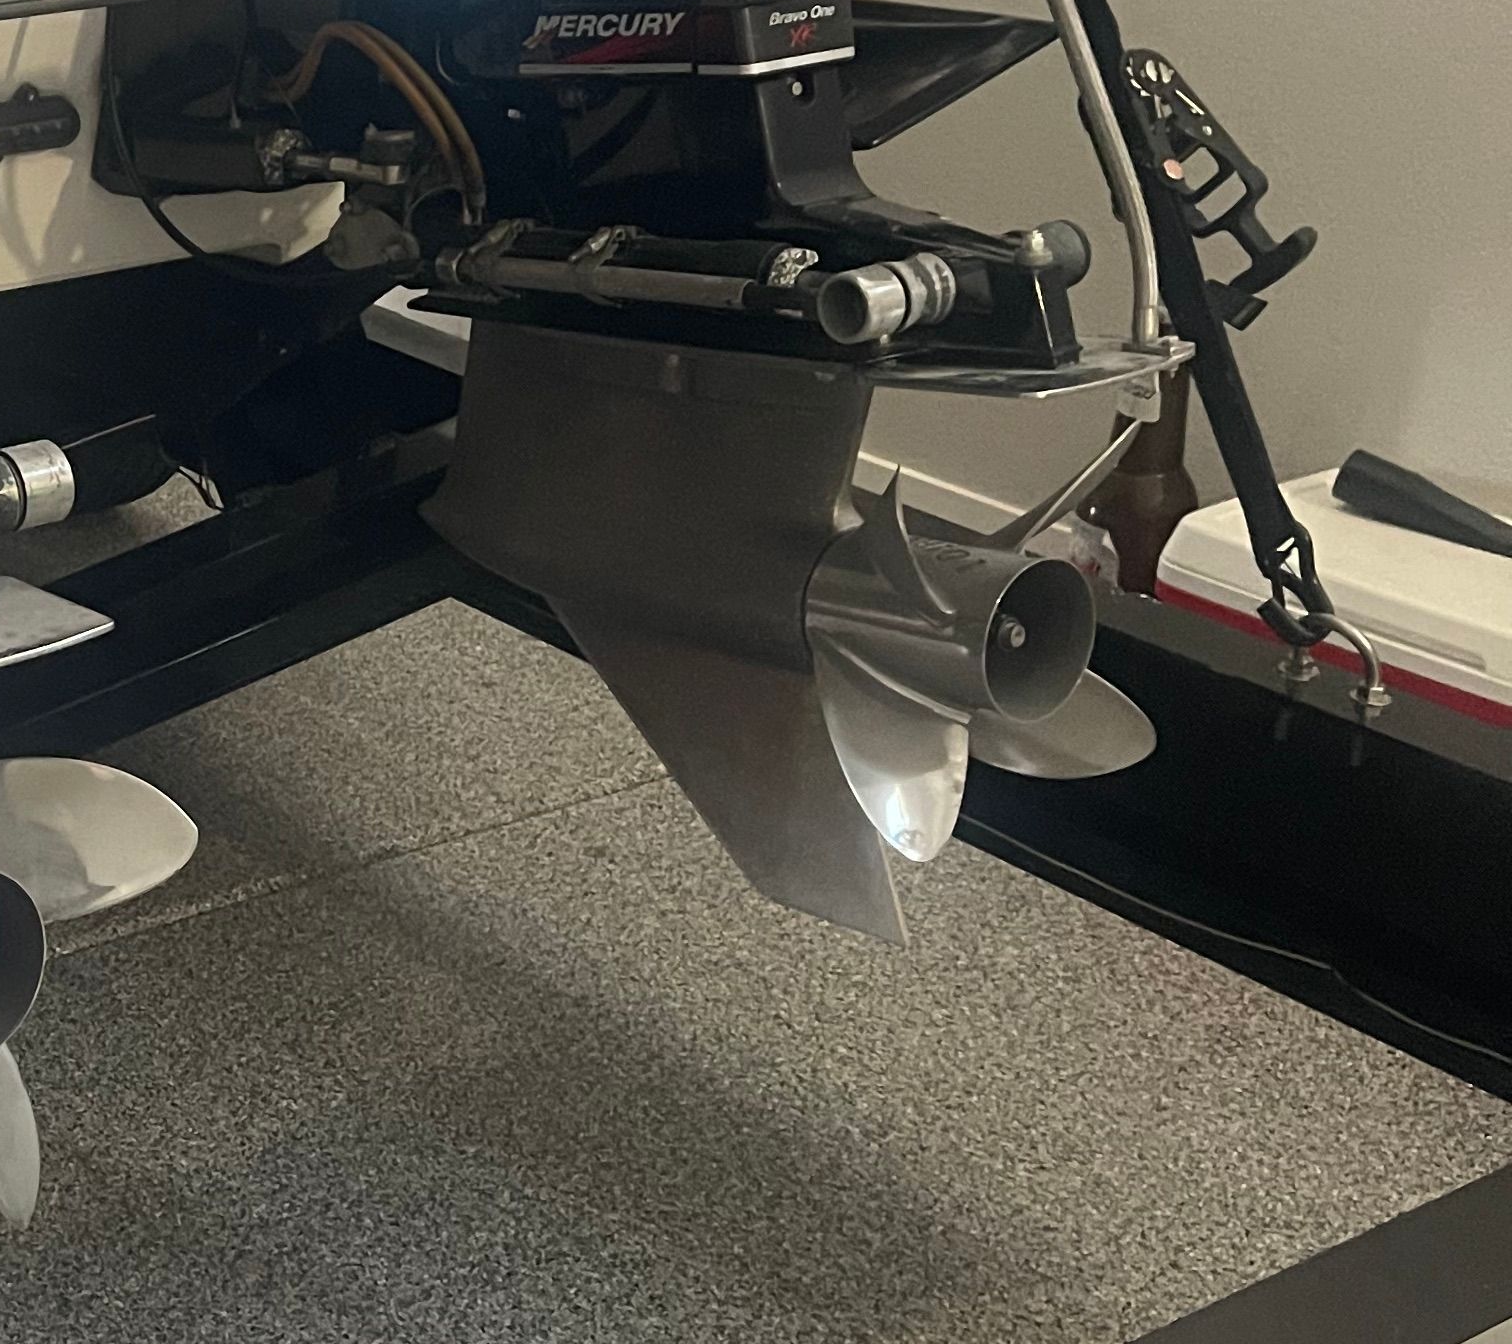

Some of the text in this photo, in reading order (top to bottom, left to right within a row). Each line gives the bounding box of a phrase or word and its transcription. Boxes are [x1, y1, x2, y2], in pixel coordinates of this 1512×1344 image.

[769, 5, 836, 26] Bravo One
[523, 12, 685, 49] MERCURY
